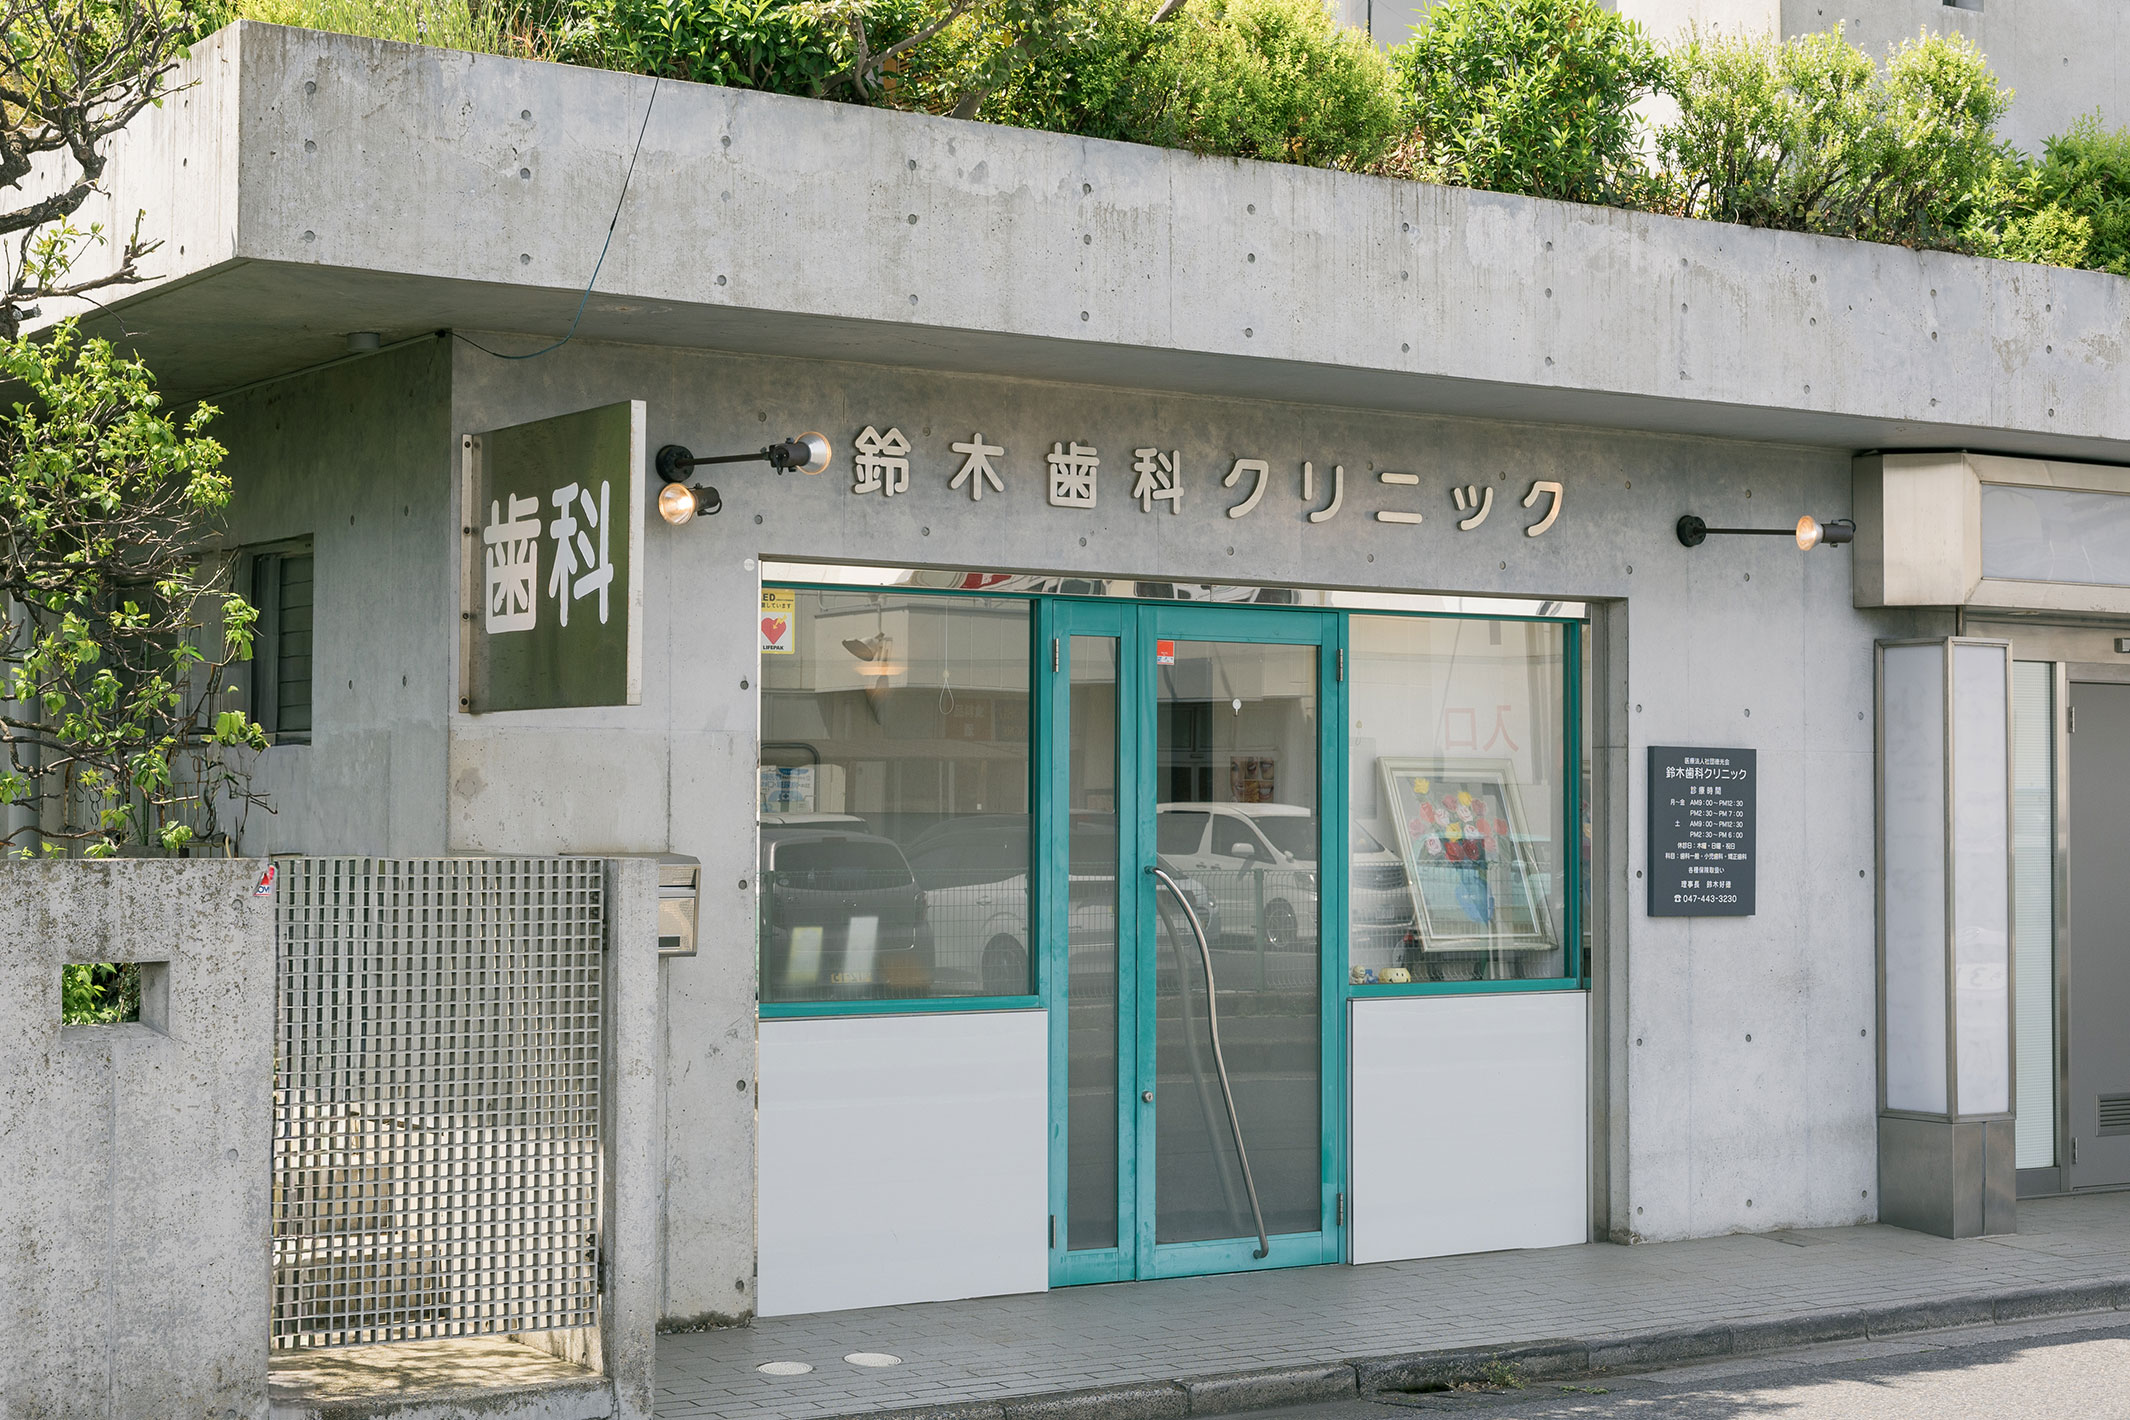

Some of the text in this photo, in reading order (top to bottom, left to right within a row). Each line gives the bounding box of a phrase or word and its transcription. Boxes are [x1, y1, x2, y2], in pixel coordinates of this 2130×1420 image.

[853, 425, 1564, 538] 鈴木歯科クリニック
[484, 480, 613, 634] 歯科
[1666, 767, 1746, 780] 鈴木歯科クリニック
[1691, 786, 1721, 795] 診療時間
